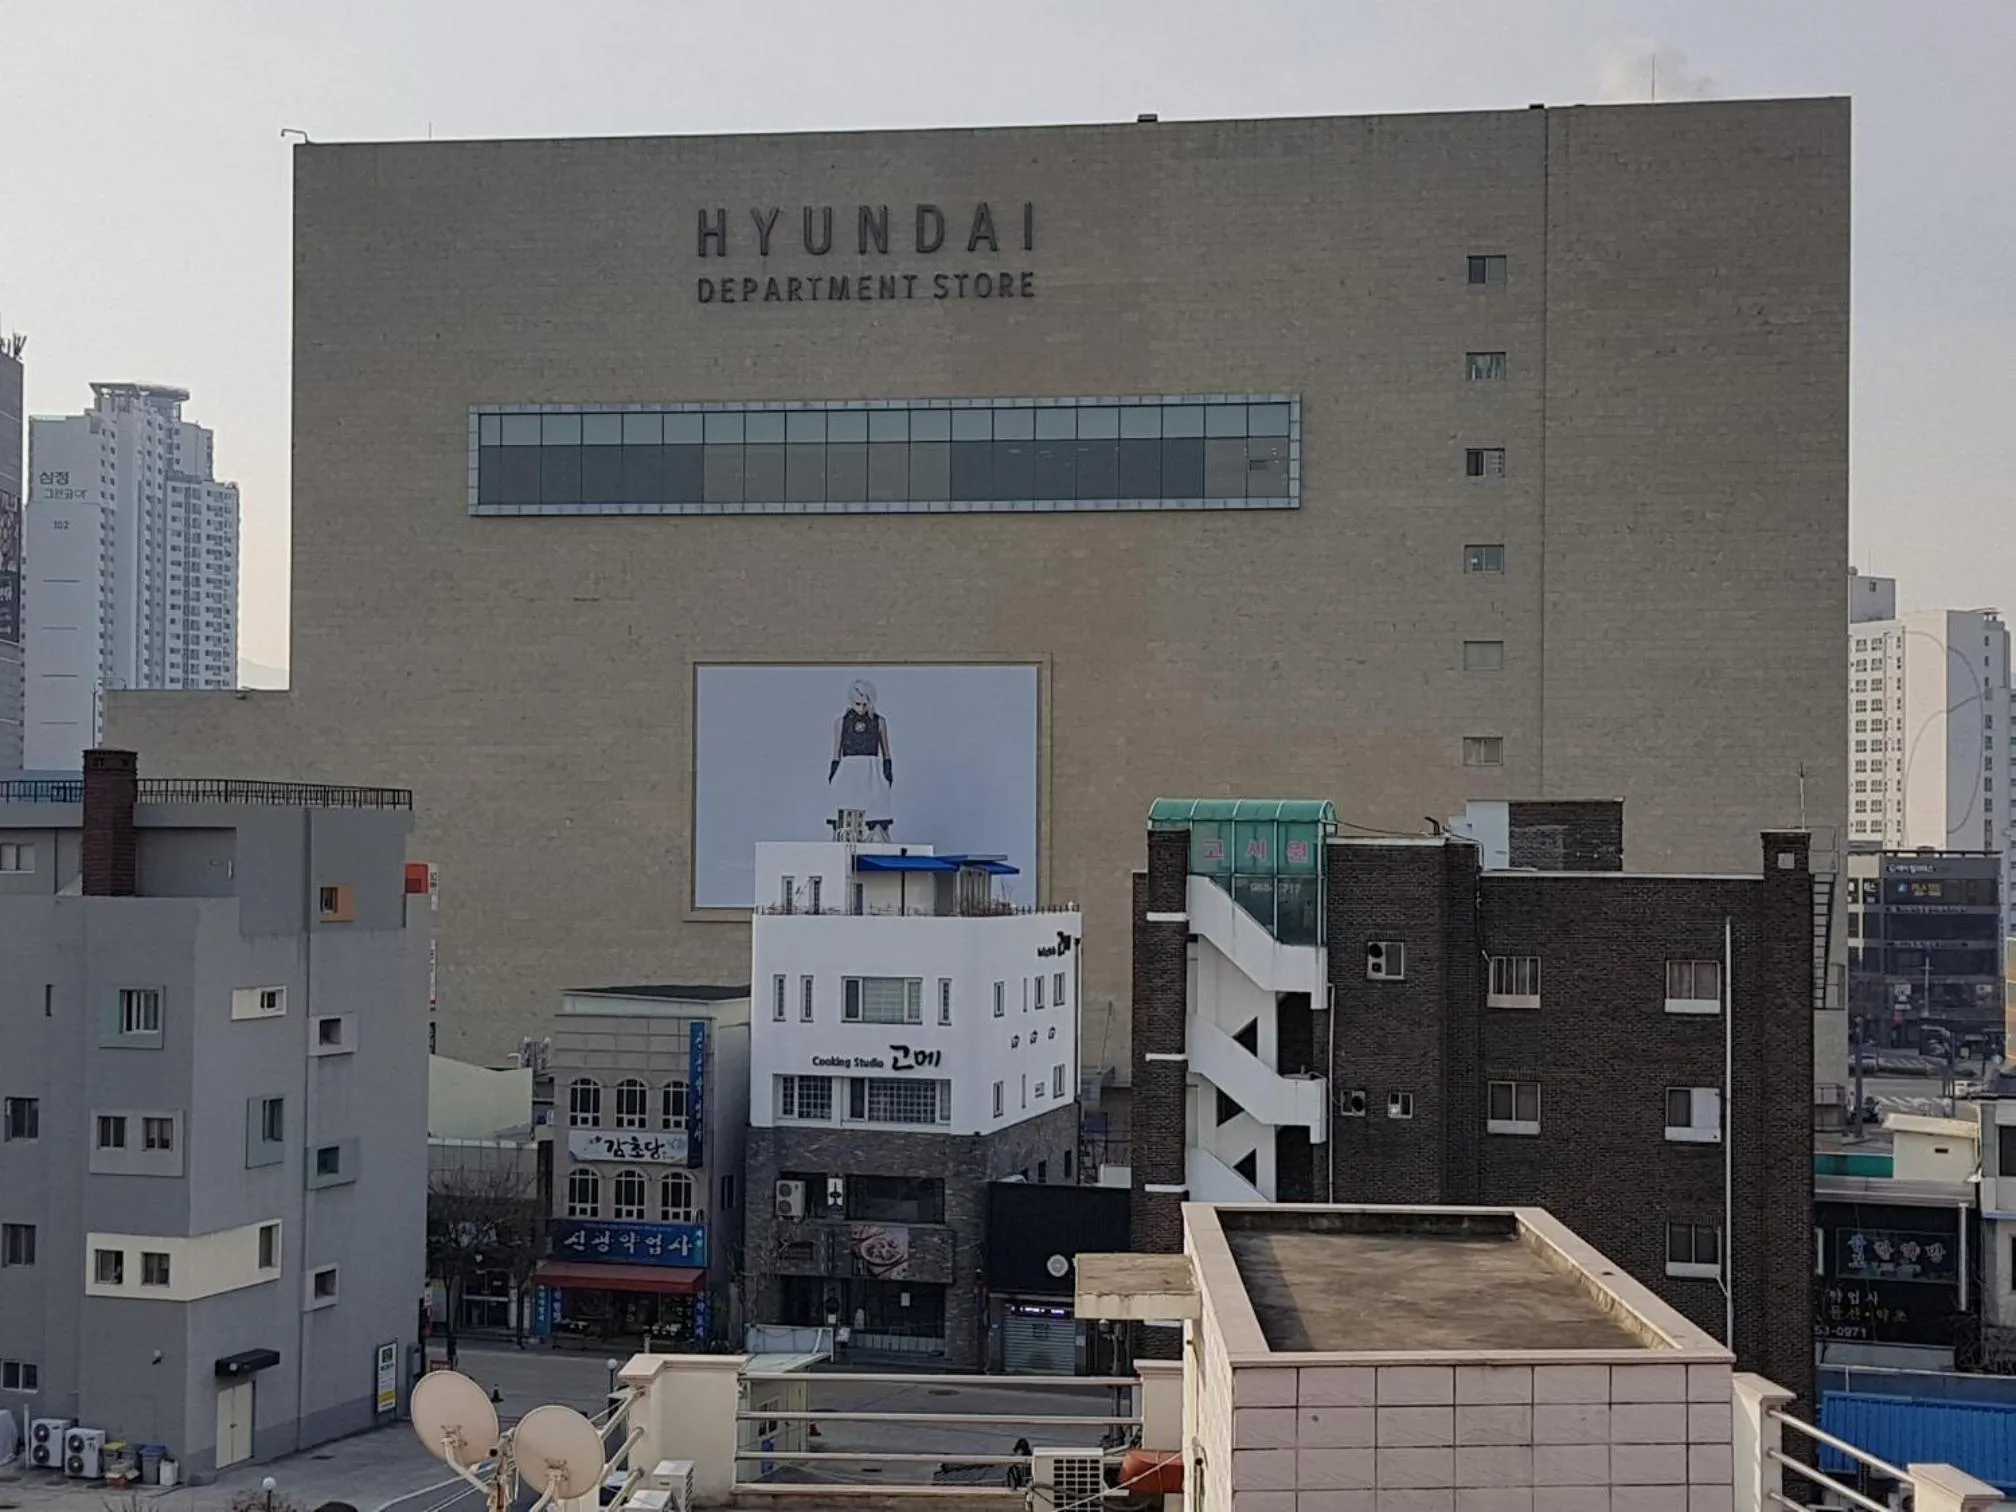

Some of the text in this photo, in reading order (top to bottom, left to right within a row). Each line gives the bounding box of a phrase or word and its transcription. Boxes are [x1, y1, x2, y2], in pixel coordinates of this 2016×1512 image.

[697, 201, 1033, 257] HYUNDAI
[697, 271, 1035, 303] DEPARTMENT STORE
[1203, 838, 1309, 863] 고시원
[812, 1056, 851, 1068] Cooking
[854, 1057, 884, 1068] Studio
